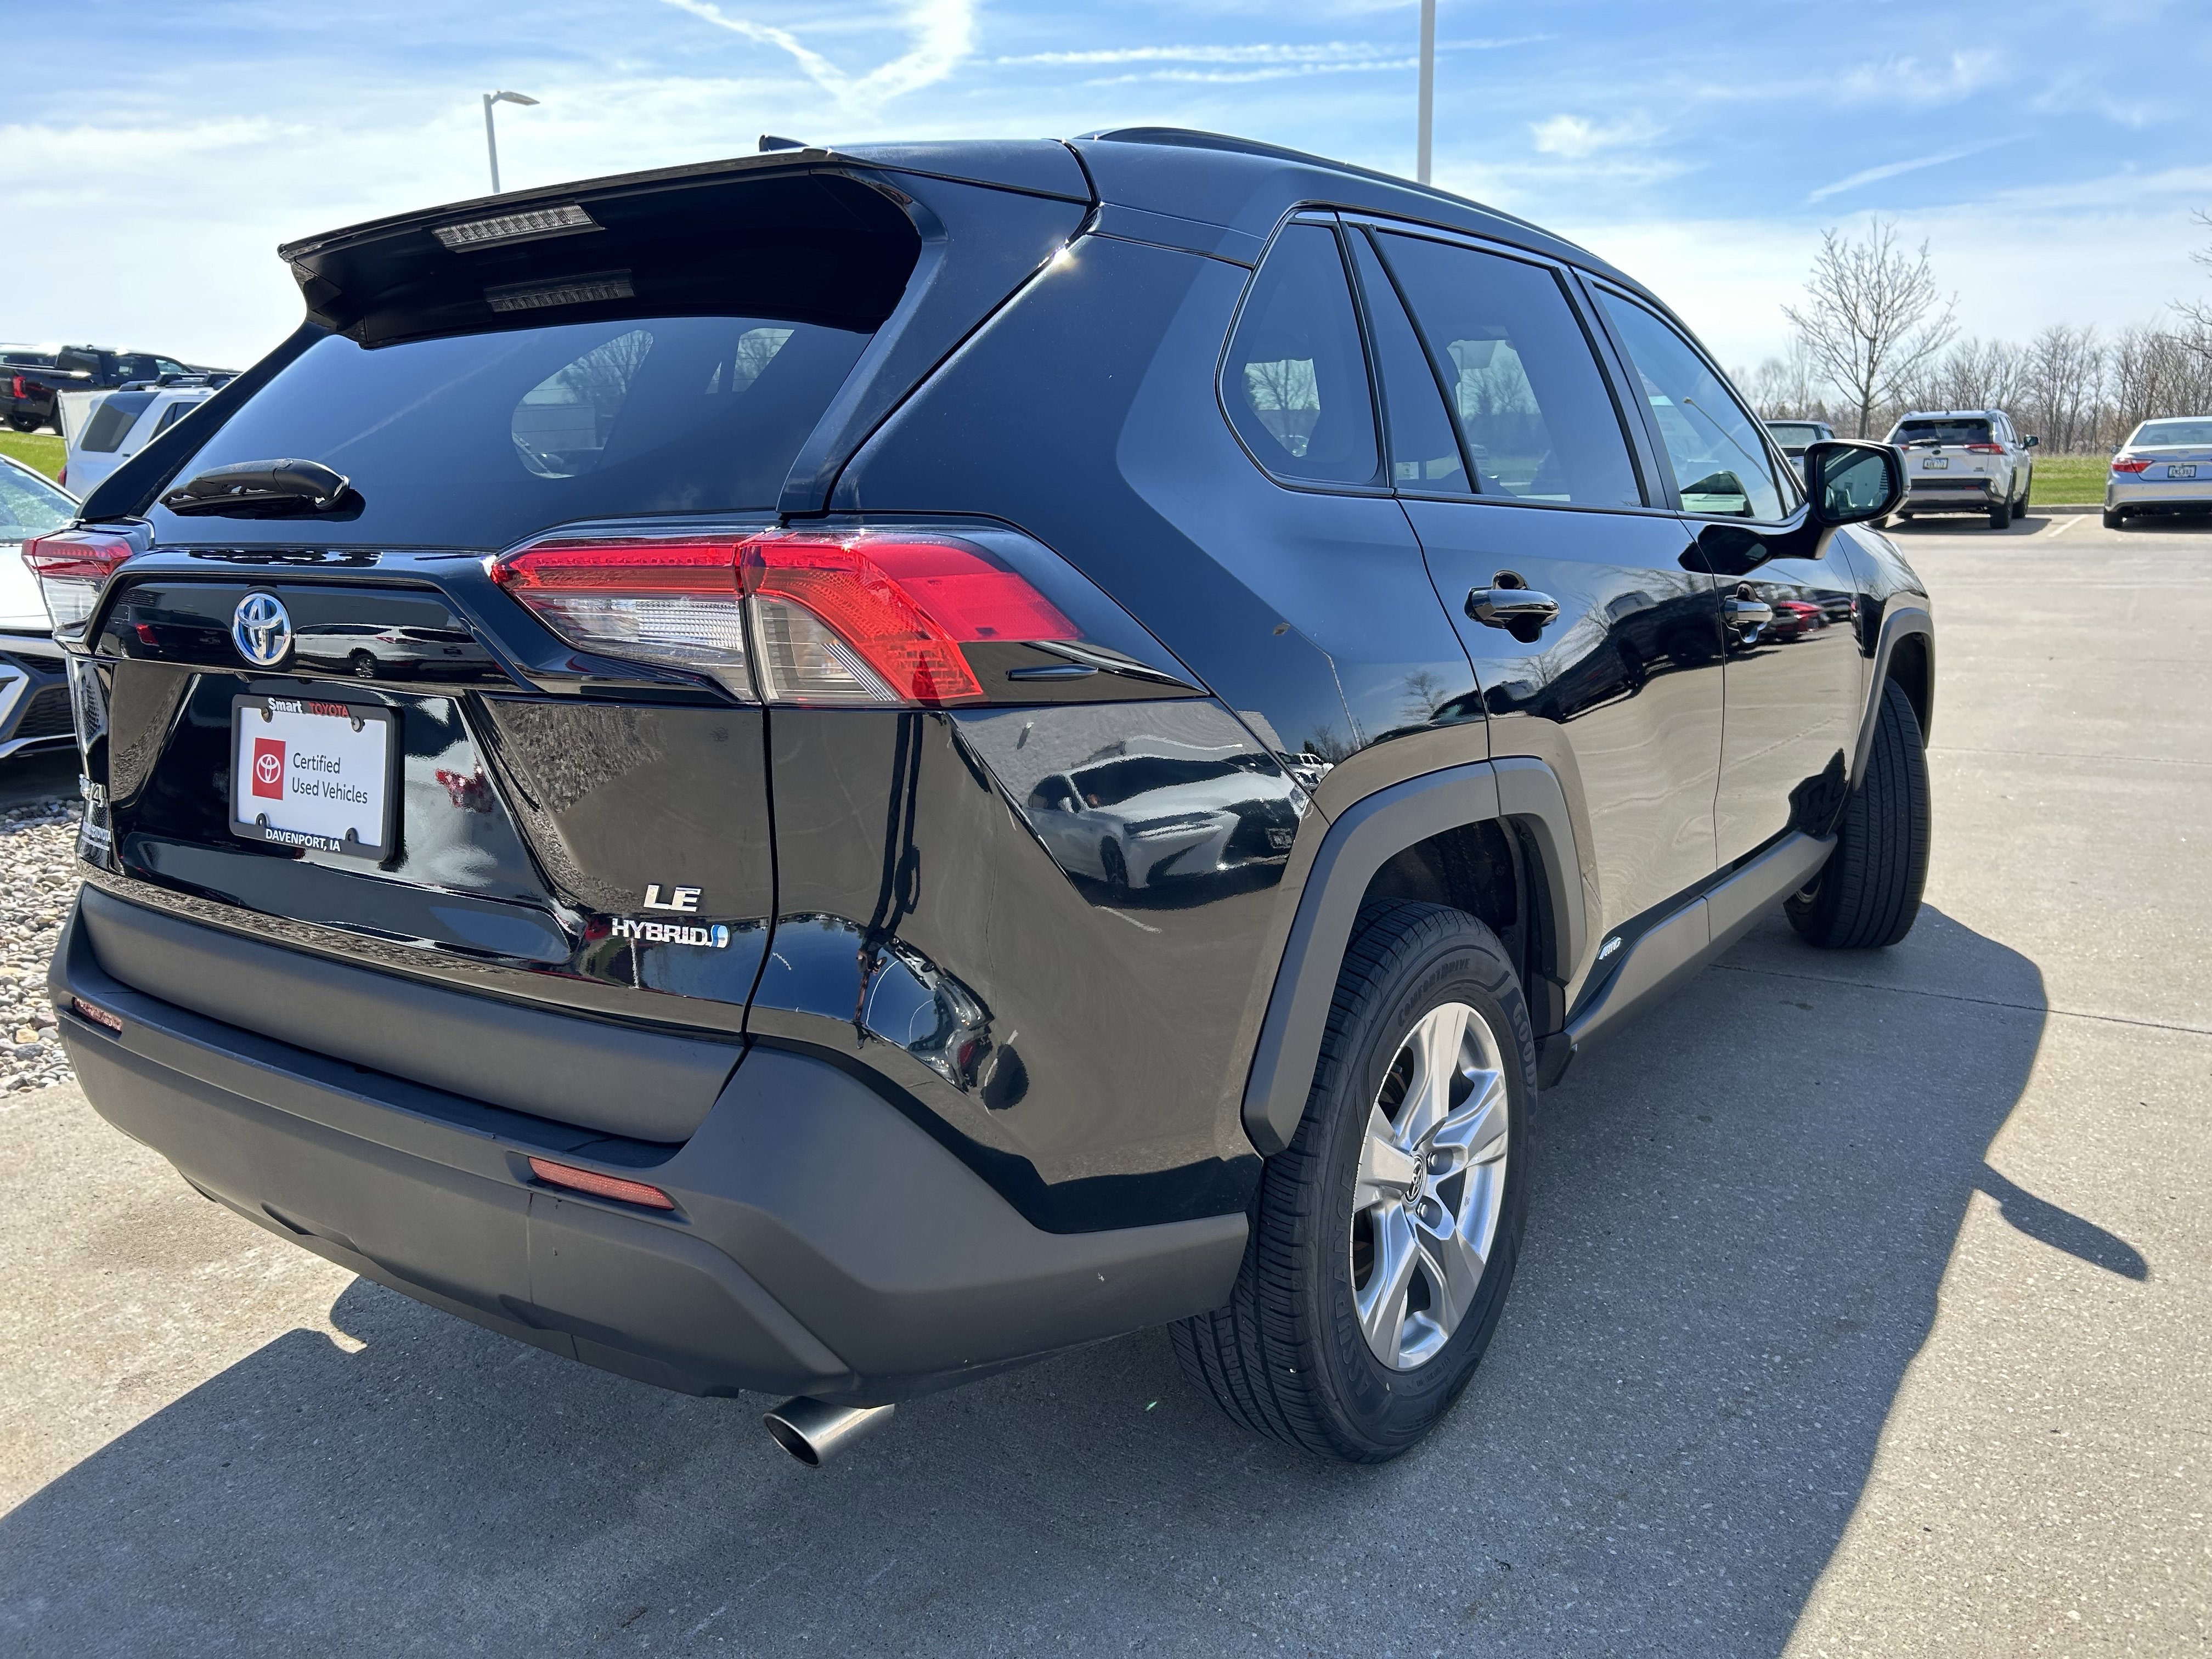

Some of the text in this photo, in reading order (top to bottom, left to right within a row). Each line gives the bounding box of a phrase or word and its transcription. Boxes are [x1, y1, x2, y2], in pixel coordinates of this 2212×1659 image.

[268, 697, 349, 718] Smart TOYOTA
[293, 752, 341, 774] Certified
[292, 777, 368, 804] Used Vehicles
[266, 829, 341, 851] DAVENPORT, IA
[643, 884, 702, 912] LE
[612, 918, 709, 946] HYBRID
